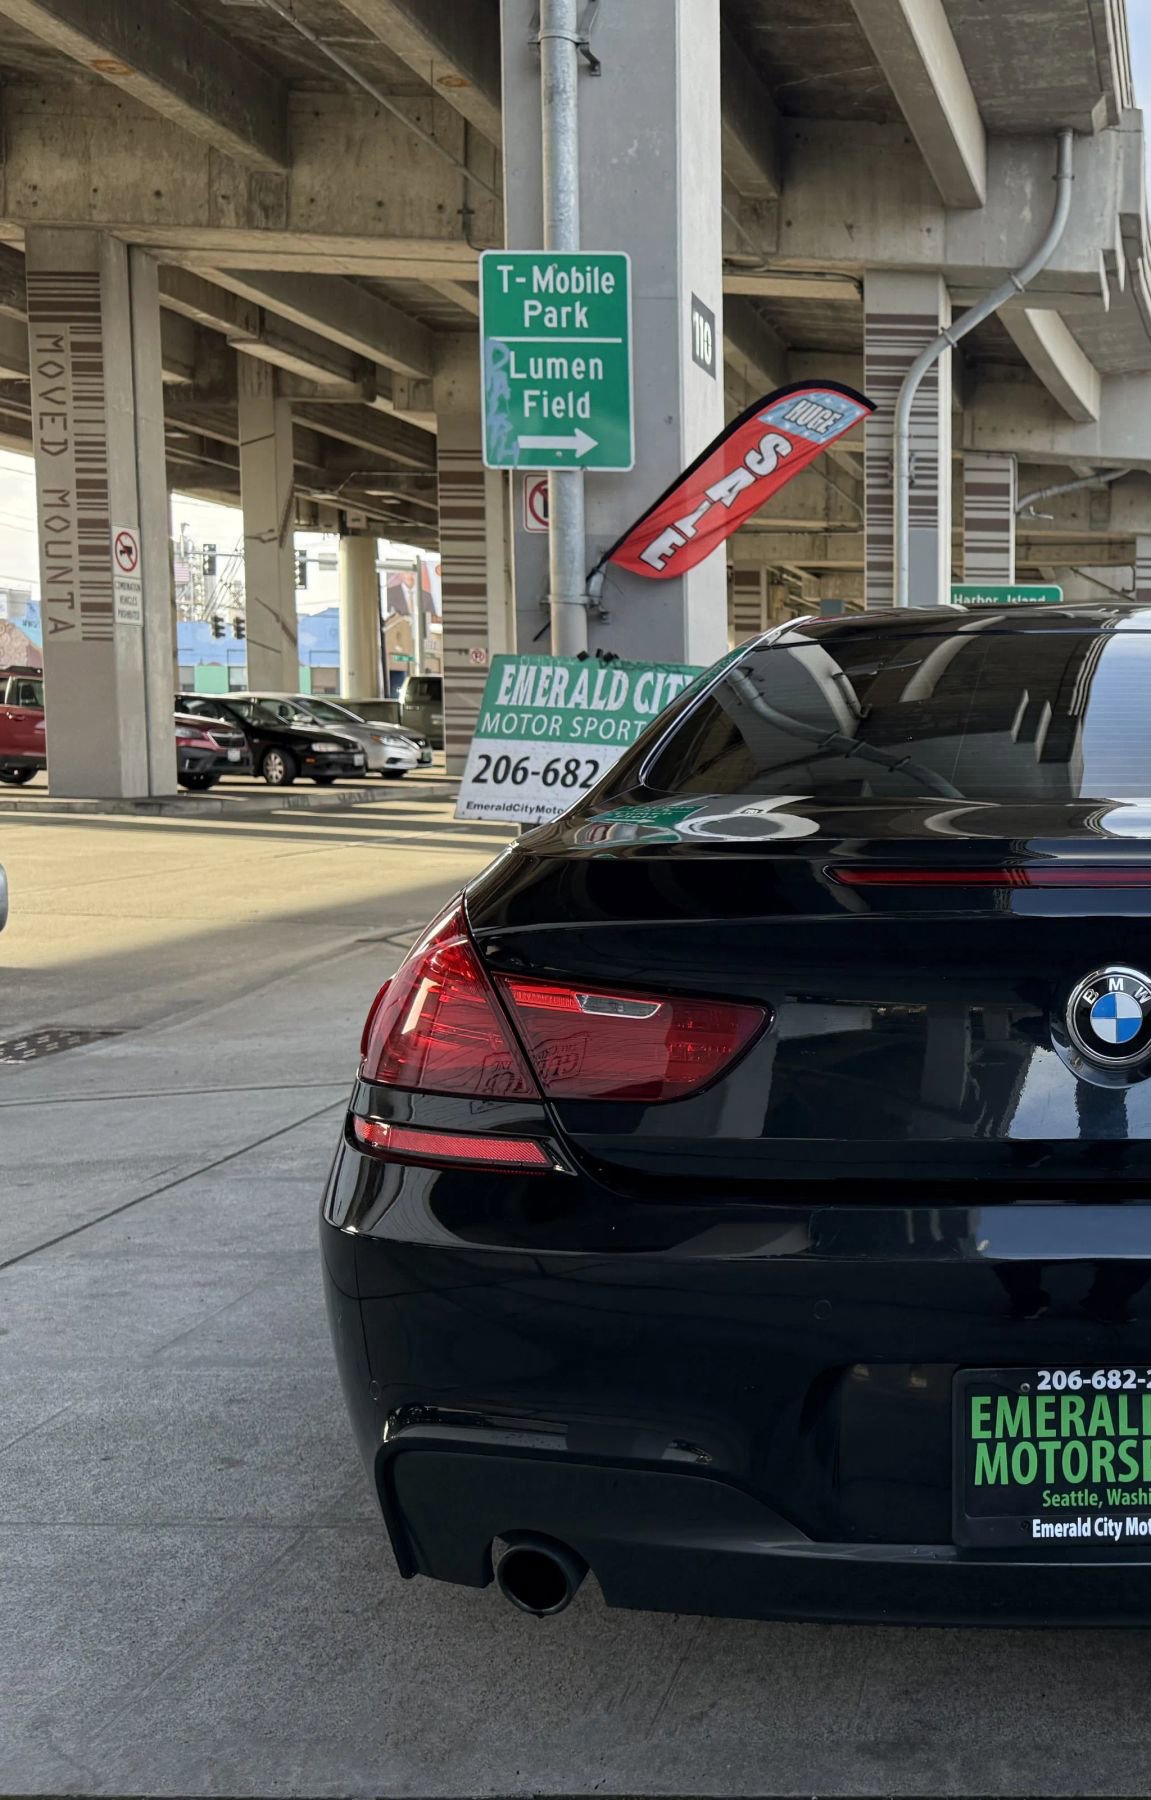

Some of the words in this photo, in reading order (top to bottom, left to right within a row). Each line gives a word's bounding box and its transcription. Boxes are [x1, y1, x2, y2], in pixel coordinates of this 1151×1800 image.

[497, 265, 615, 294] T-Mobile
[523, 300, 589, 328] Park
[693, 310, 712, 366] 110
[509, 351, 603, 380] Lumen
[35, 334, 69, 457] MOVED
[523, 391, 591, 418] Field
[784, 399, 844, 435] HUGE
[639, 432, 793, 571] SALE
[42, 489, 75, 635] MOUNTA
[495, 664, 629, 711] EMERALD
[481, 712, 562, 736] MOTOR
[1083, 978, 1151, 1005] BMW
[1042, 1489, 1102, 1508] Seattle,
[1032, 1518, 1091, 1538] Emerald
[1094, 1517, 1122, 1541] City
